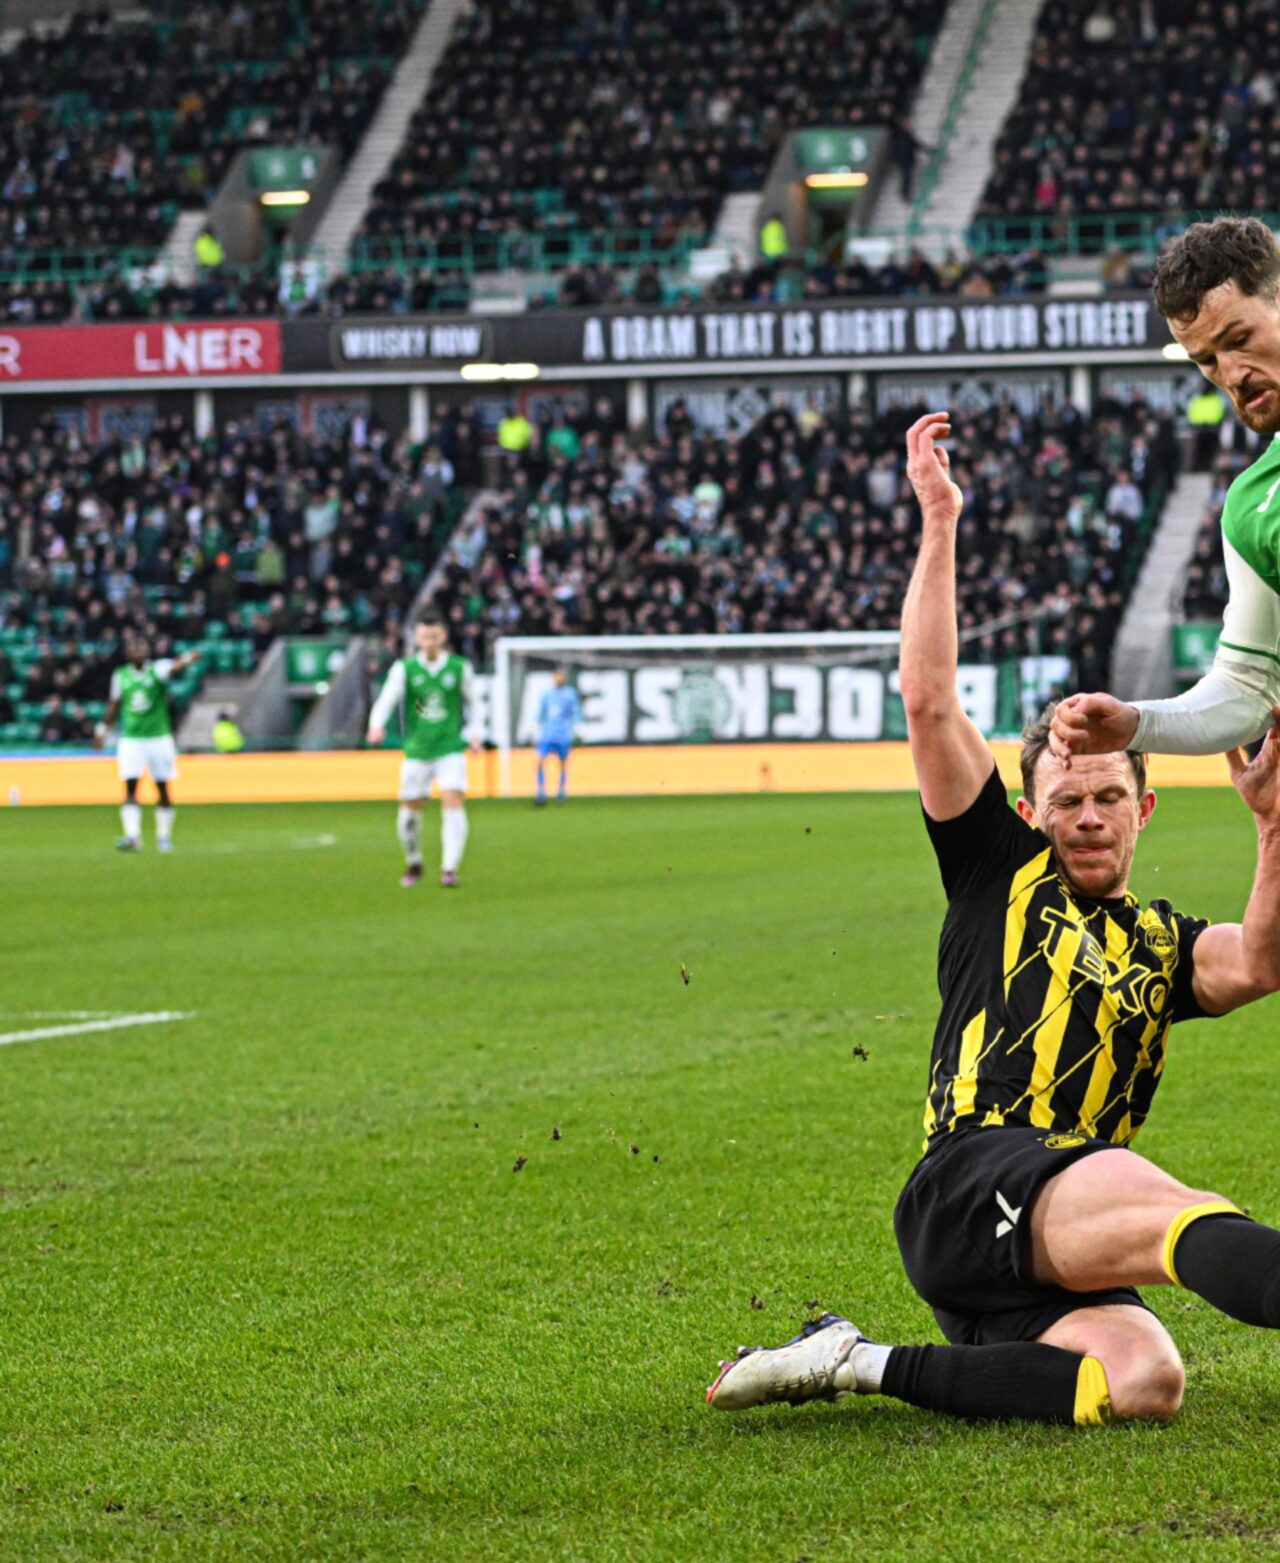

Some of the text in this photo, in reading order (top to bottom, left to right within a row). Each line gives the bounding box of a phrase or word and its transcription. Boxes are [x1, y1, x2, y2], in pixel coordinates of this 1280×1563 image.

[134, 325, 262, 375] LNER
[583, 317, 605, 361] A
[702, 312, 776, 358] THAT
[783, 310, 814, 355] IS
[914, 306, 955, 351] UP
[961, 304, 1039, 350] YOUR
[1044, 301, 1148, 347] STREET
[711, 664, 997, 738] BOCK
[1040, 905, 1172, 1022] TEXO
